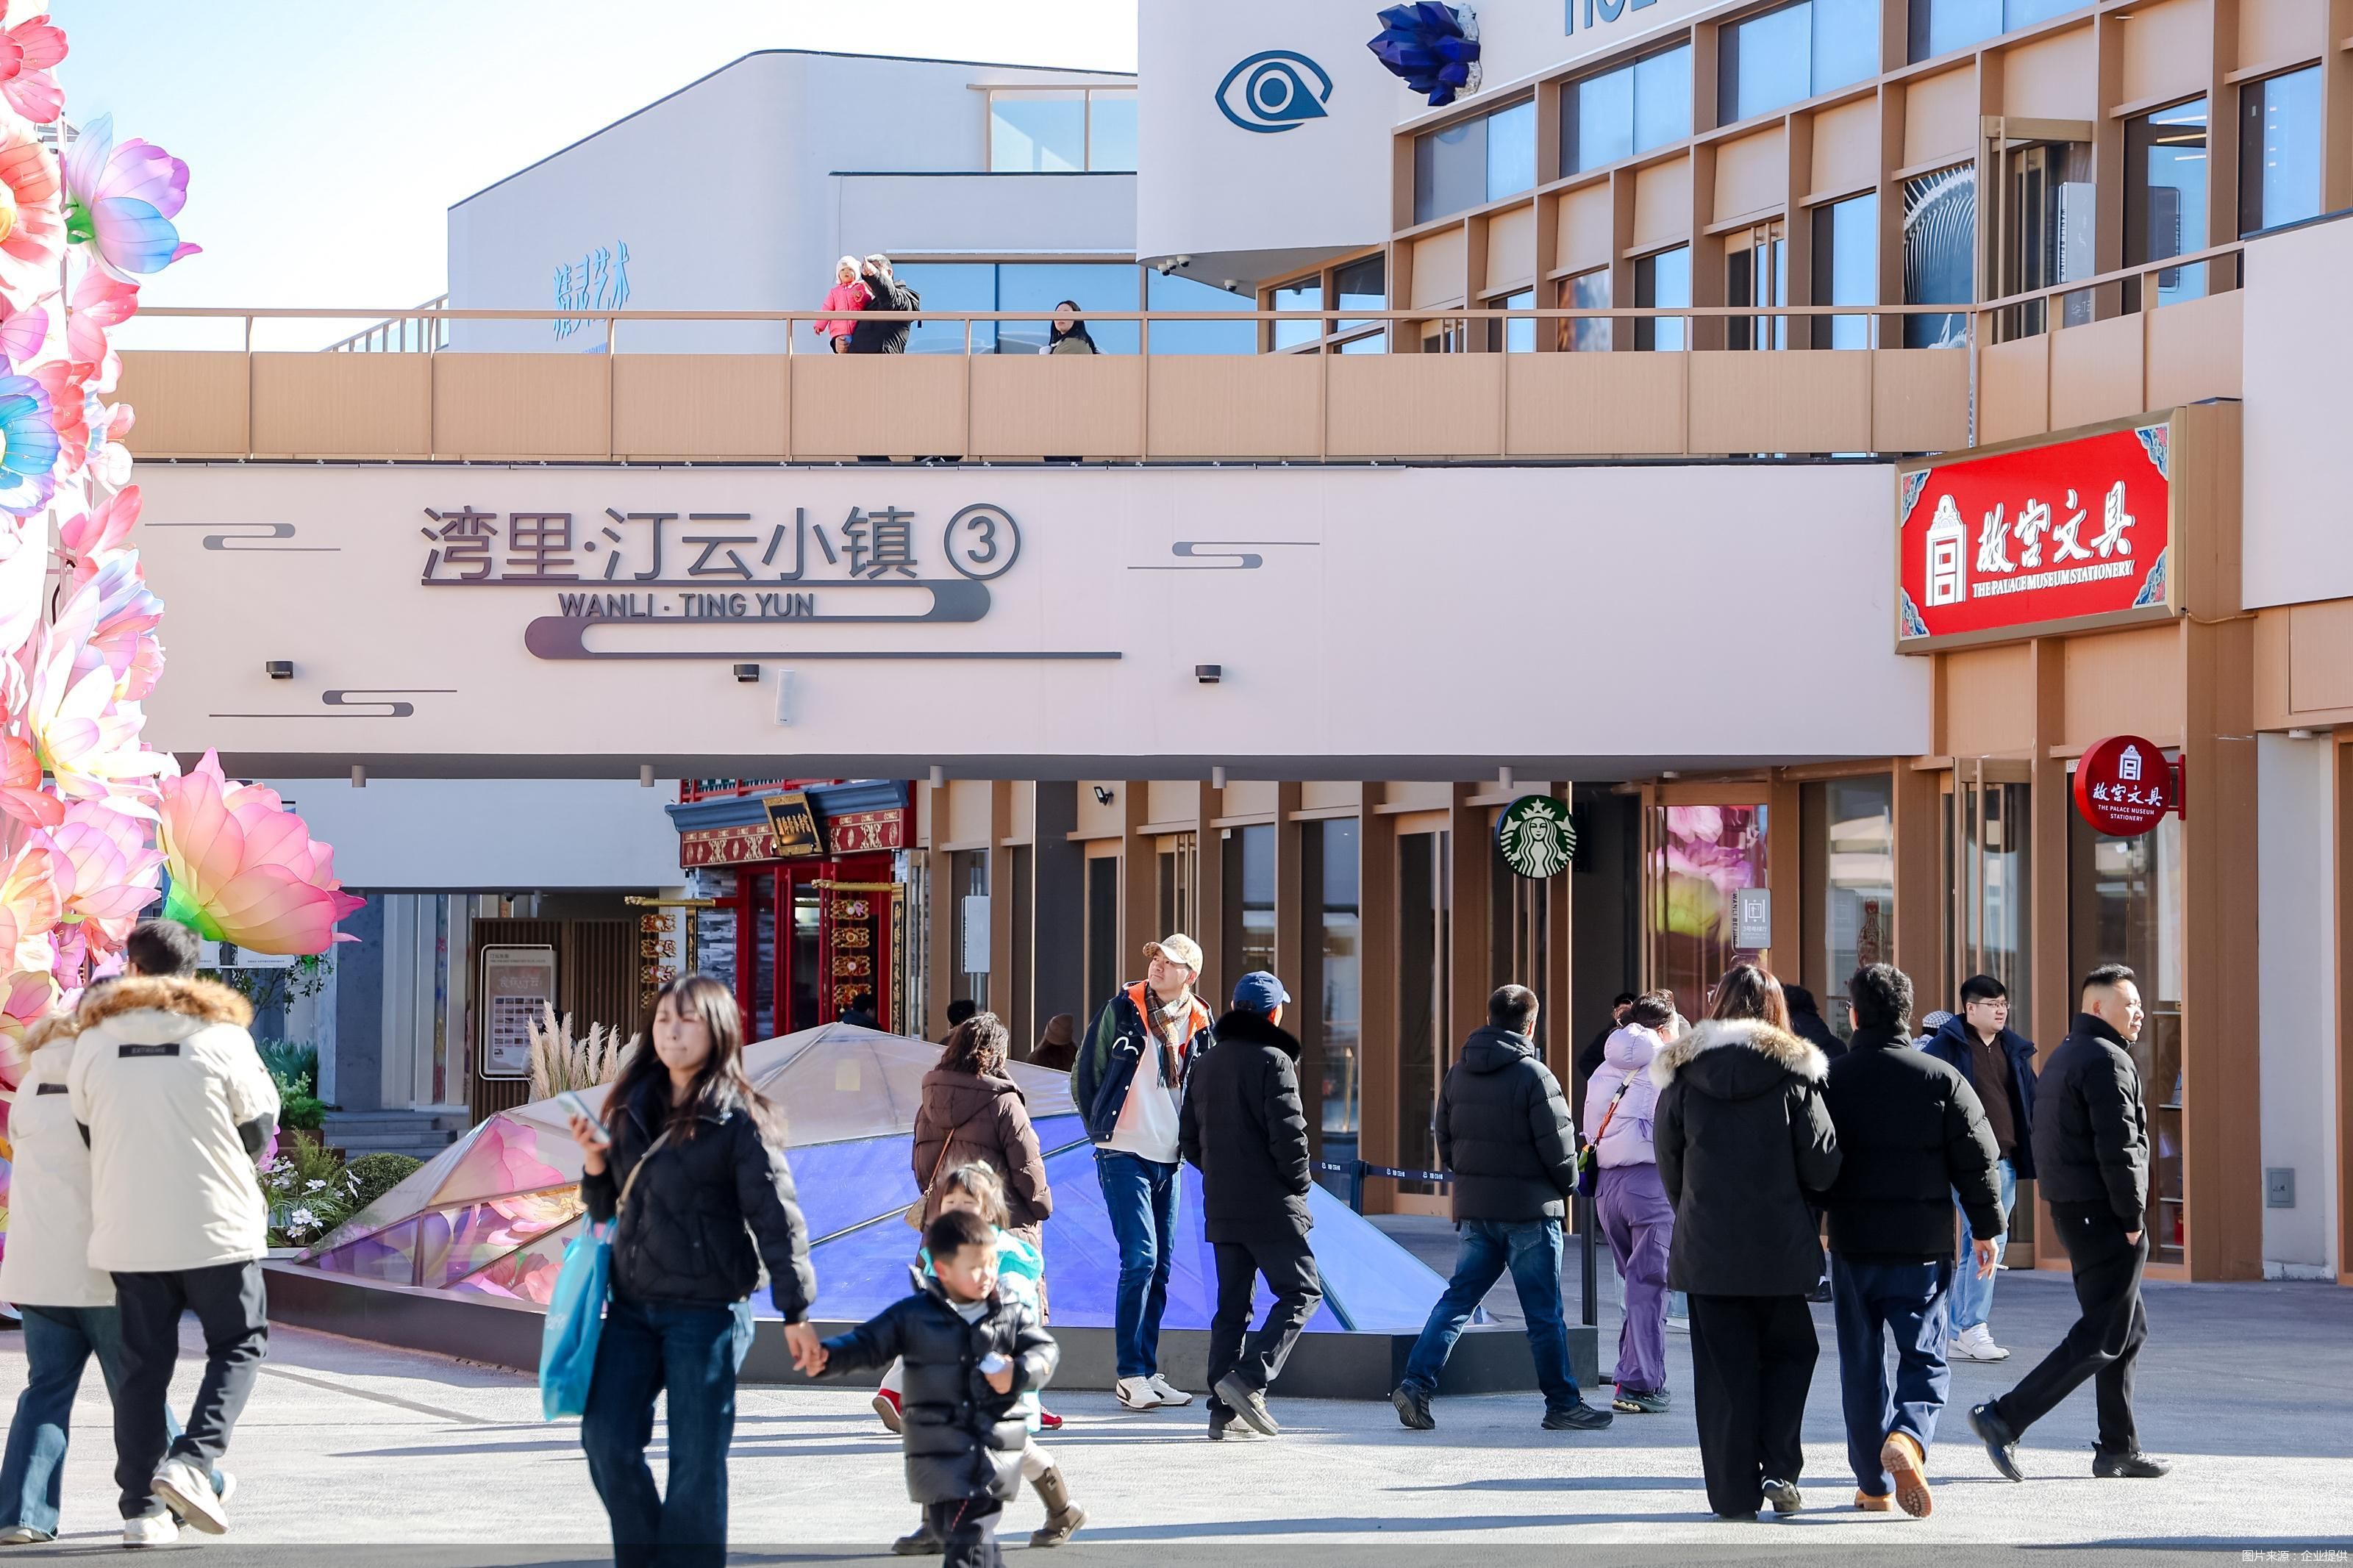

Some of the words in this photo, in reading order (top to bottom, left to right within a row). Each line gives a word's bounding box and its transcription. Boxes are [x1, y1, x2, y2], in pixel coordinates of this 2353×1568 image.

[1976, 480, 2136, 573] 故宫文具
[422, 505, 917, 581] 湾里·汀云小镇
[1972, 582, 1990, 598] THE
[1990, 578, 2027, 596] PALACE
[2027, 568, 2071, 591] MUSEUM
[2070, 559, 2135, 584] STATIONERY
[558, 592, 654, 617] WANLI
[679, 592, 746, 617] TING
[756, 592, 815, 617] YUN
[2093, 781, 2163, 807] 故宫文具
[2110, 813, 2143, 822] STATIONERY
